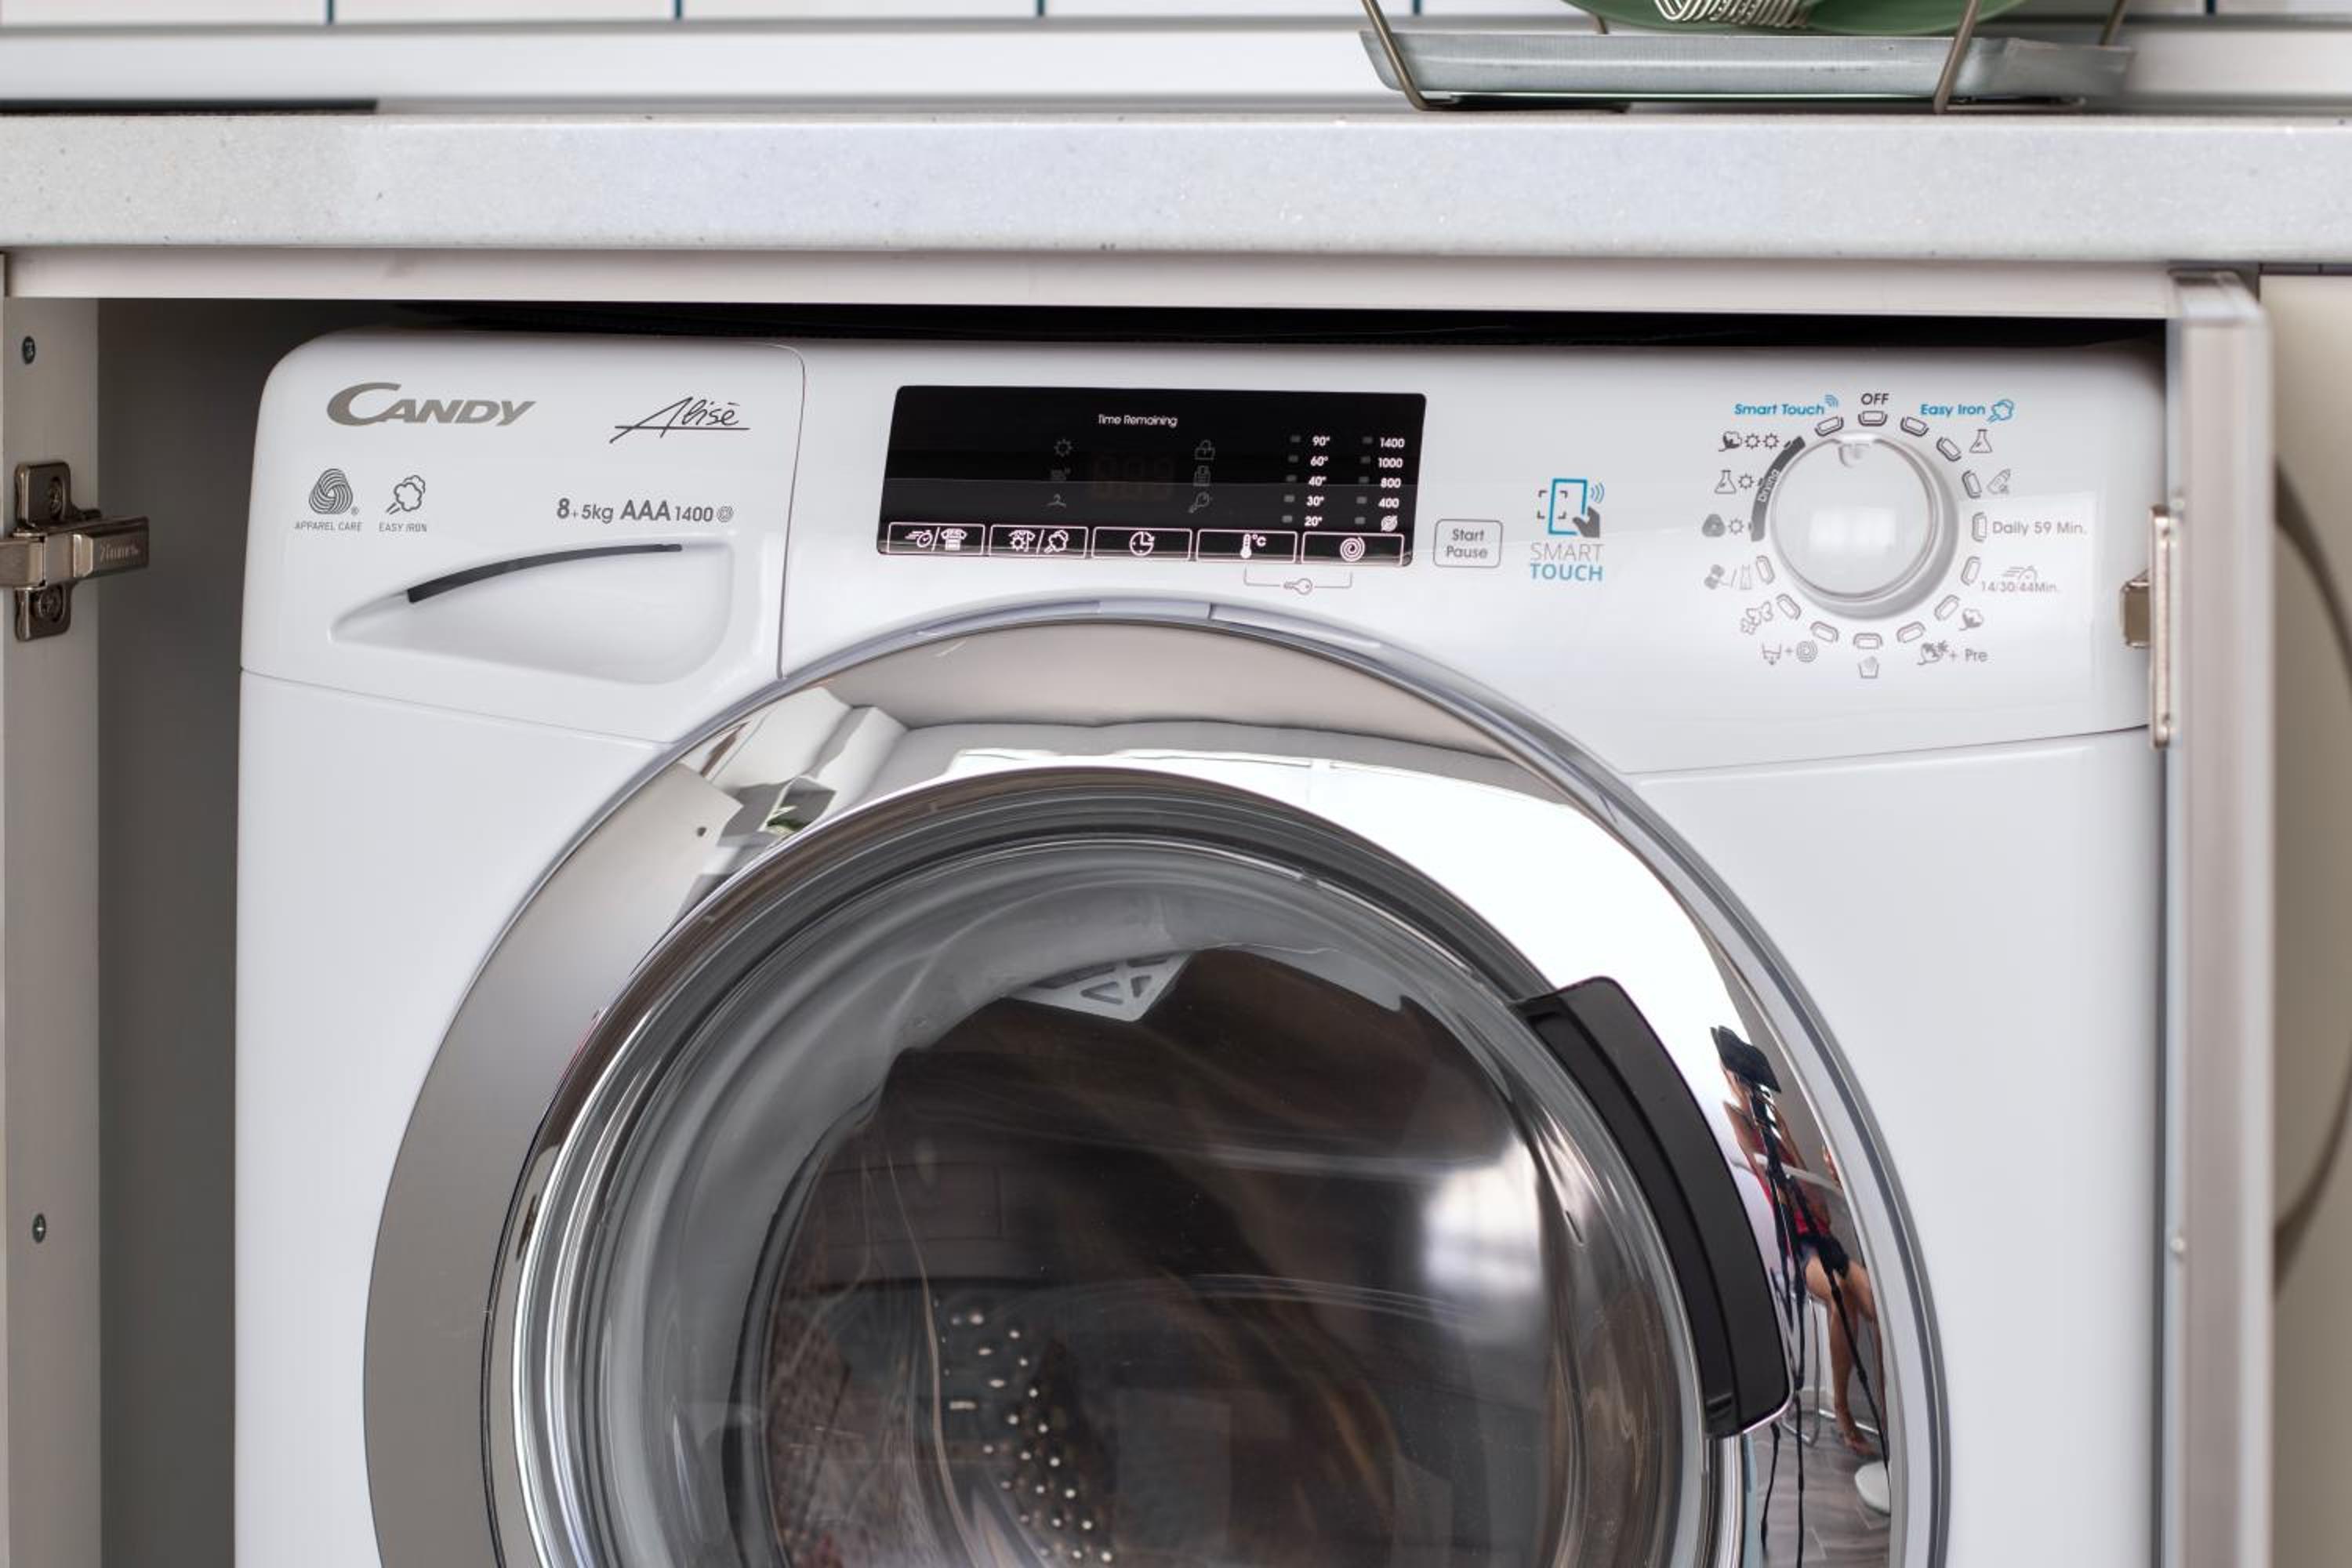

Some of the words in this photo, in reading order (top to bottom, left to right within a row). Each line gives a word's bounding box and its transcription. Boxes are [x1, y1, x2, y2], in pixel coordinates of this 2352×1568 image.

[326, 382, 536, 426] CANDY
[1860, 392, 1889, 406] OFF
[1733, 402, 1777, 416] Smart
[1782, 403, 1826, 416] Touch
[1920, 403, 1954, 418] Easy
[1958, 404, 1987, 416] Iron
[1098, 413, 1122, 425] Time
[1123, 415, 1178, 428] Remaining
[1380, 437, 1406, 448] 1400
[1377, 456, 1404, 469] 1000
[1380, 477, 1402, 489] 800
[1377, 497, 1399, 509] 400
[619, 499, 671, 521] AAA
[676, 506, 713, 522] 1400
[294, 521, 336, 532] APPAREL
[338, 522, 363, 532] CARE
[379, 523, 402, 532] EASY
[405, 523, 427, 532] IRON
[1992, 521, 2029, 536] Daily
[2034, 522, 2052, 534] 59
[1452, 528, 1485, 542] Start
[1446, 545, 1488, 559] Pause
[1530, 543, 1604, 561] SMART
[1530, 563, 1603, 582] TOUCH
[1965, 649, 1988, 662] Pre
